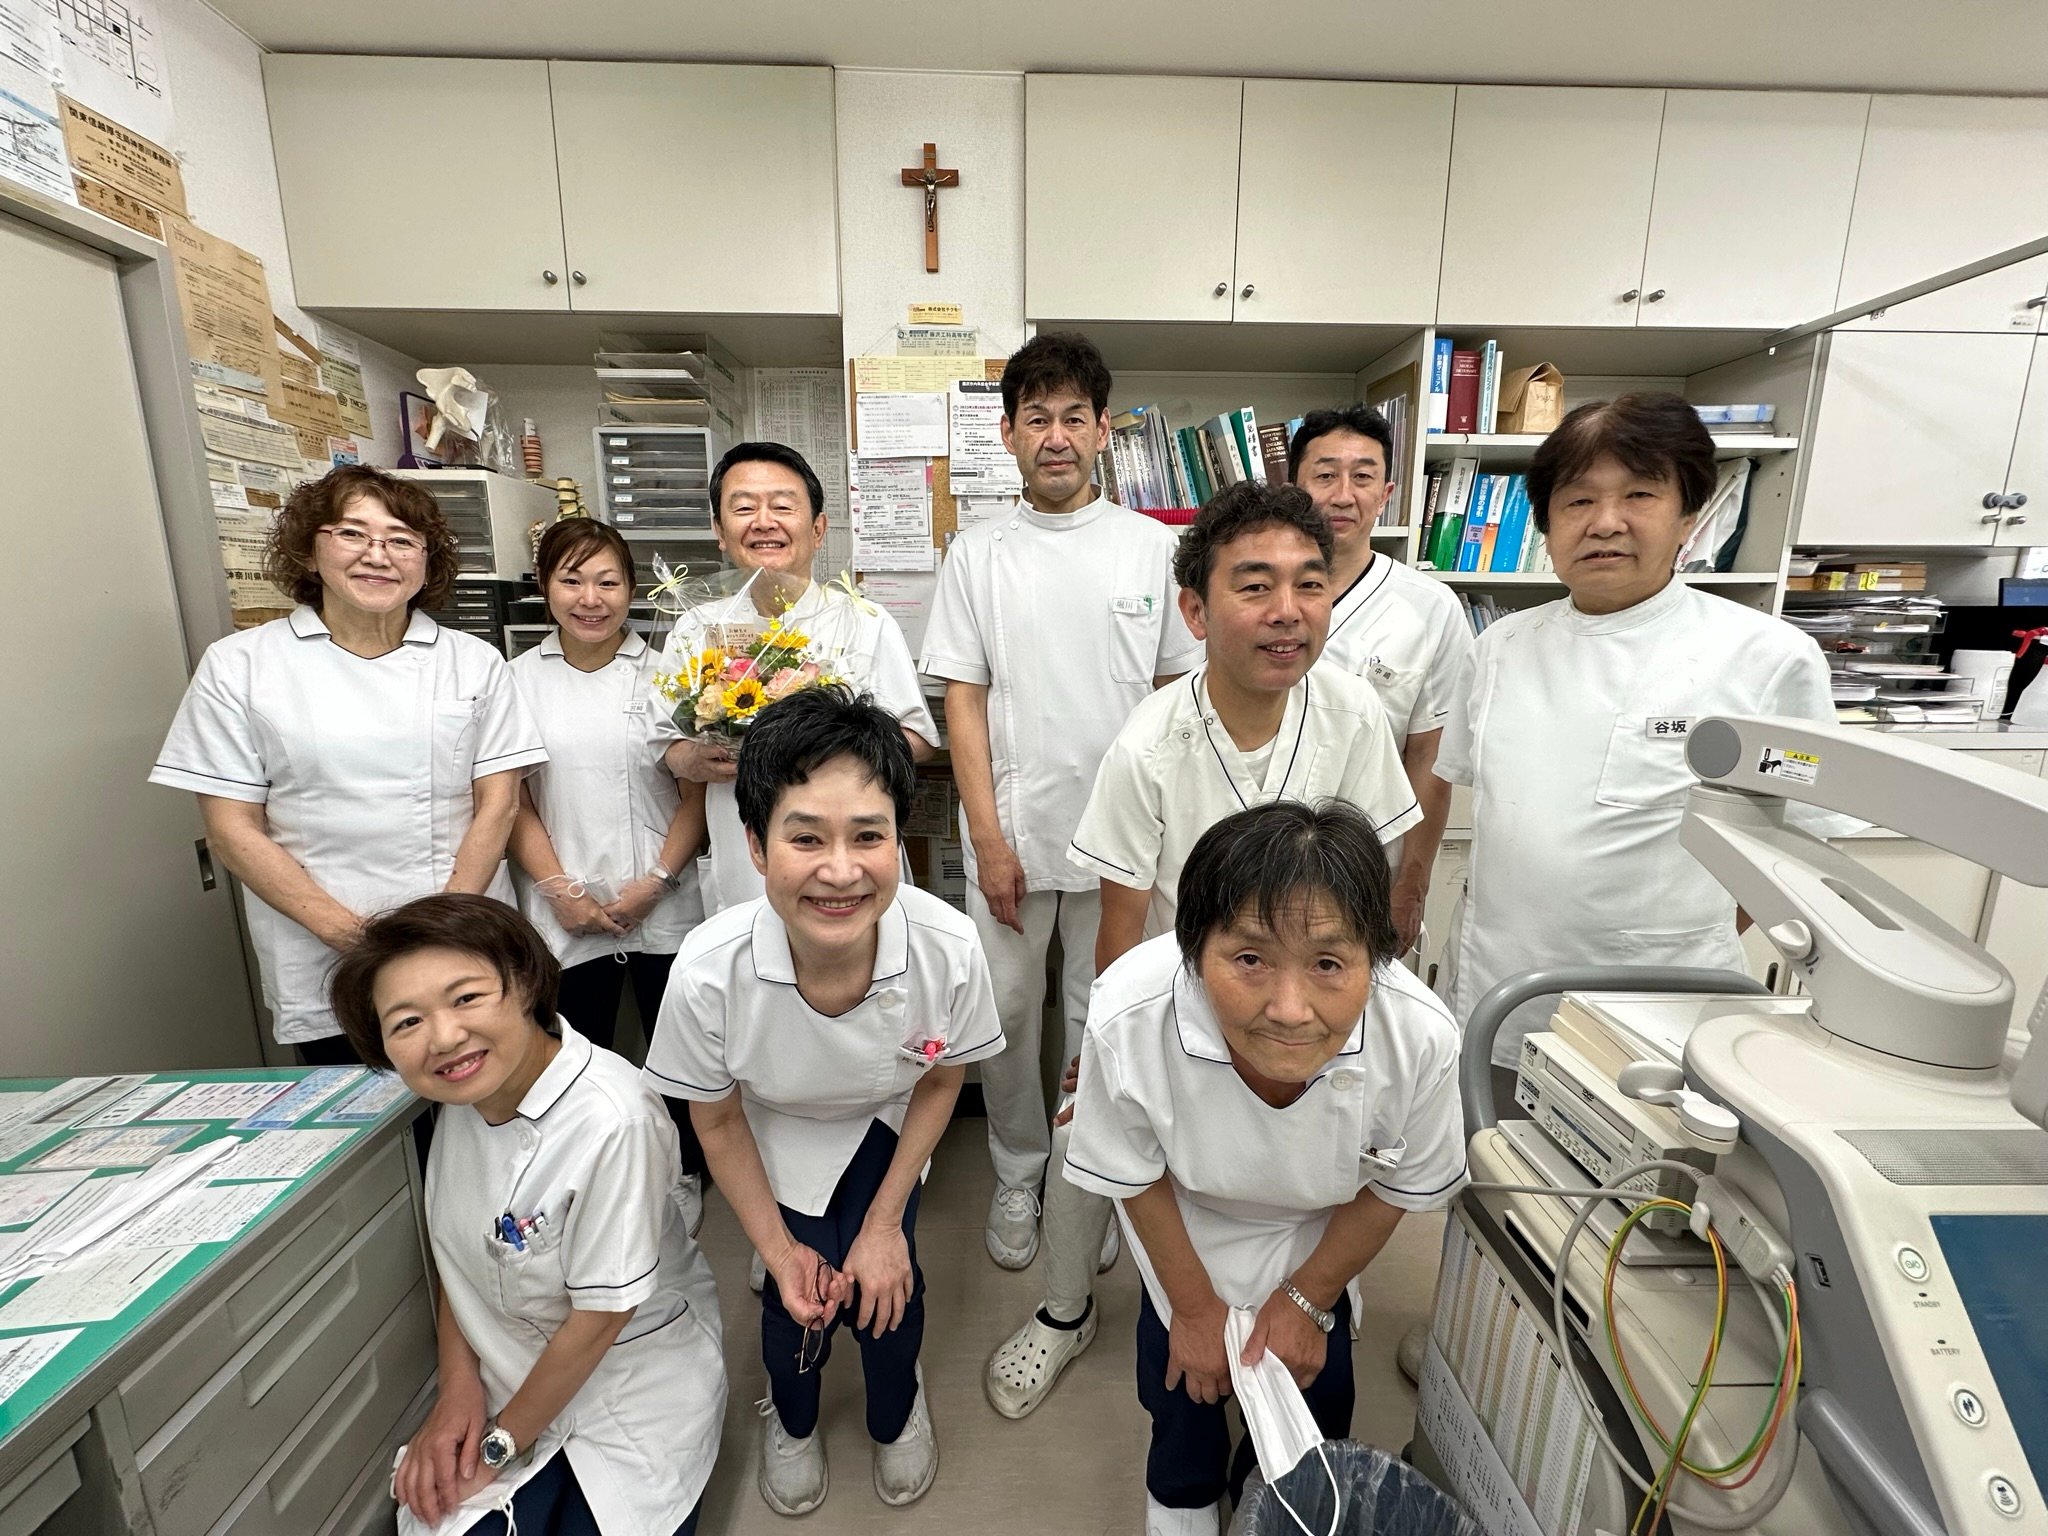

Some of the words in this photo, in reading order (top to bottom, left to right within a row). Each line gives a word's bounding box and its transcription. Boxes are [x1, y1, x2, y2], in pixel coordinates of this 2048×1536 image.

[1654, 720, 1687, 734] 谷坂
[1913, 1300, 1941, 1308] STANDBY
[1930, 1348, 1960, 1356] BATTERY
